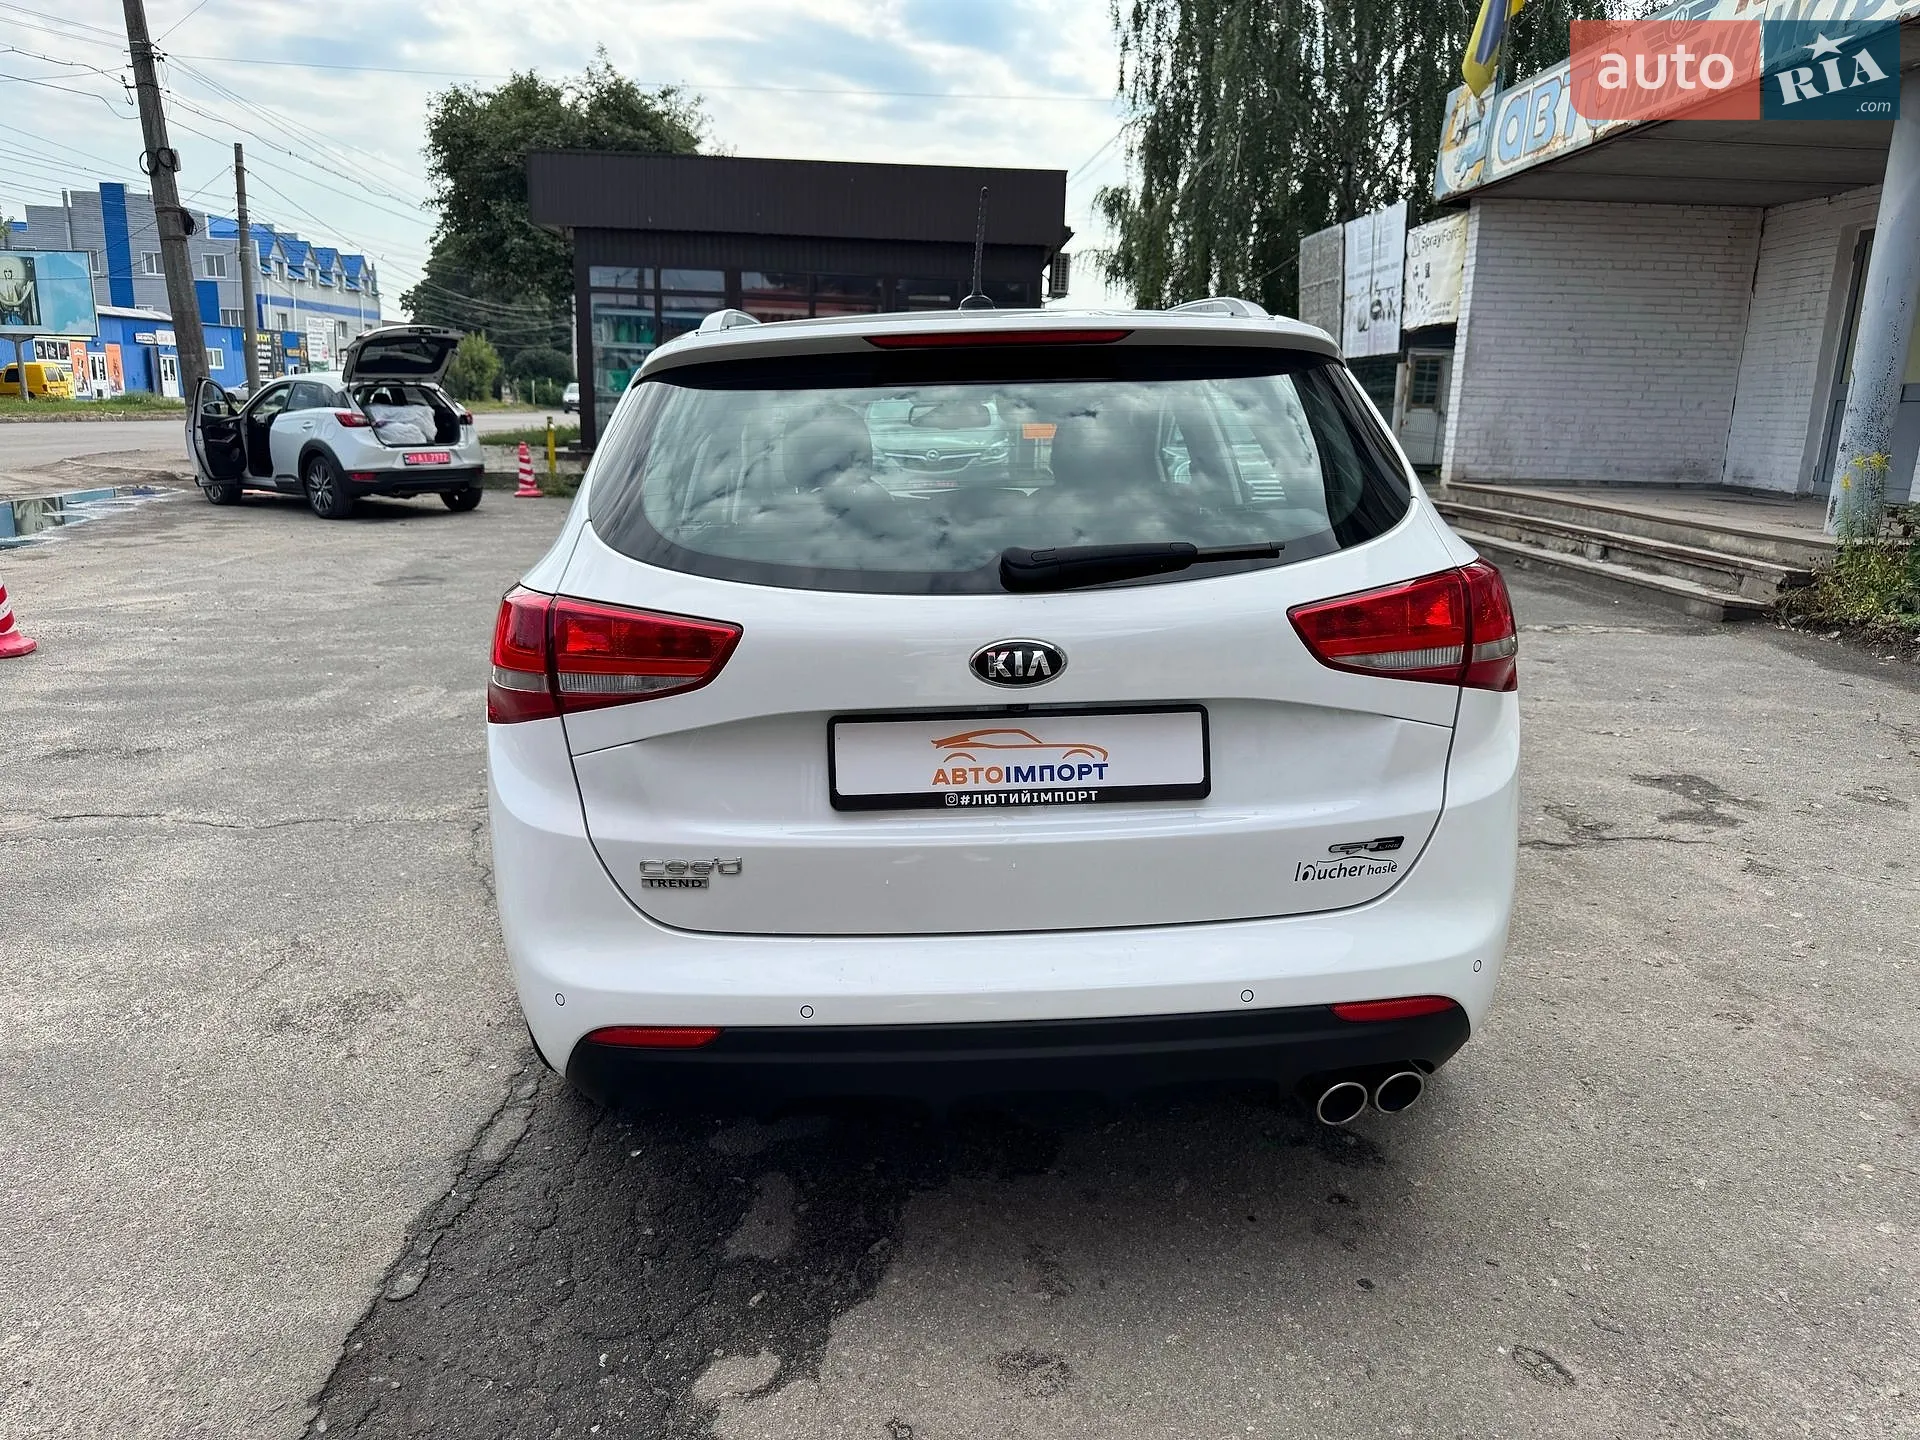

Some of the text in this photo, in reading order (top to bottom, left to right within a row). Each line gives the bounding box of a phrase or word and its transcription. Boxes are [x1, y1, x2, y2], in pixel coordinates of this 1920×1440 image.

[986, 650, 1052, 678] KIA
[932, 763, 1109, 786] АВТОІМПОРТ
[1366, 861, 1398, 876] hasle
[647, 879, 704, 889] TREND
